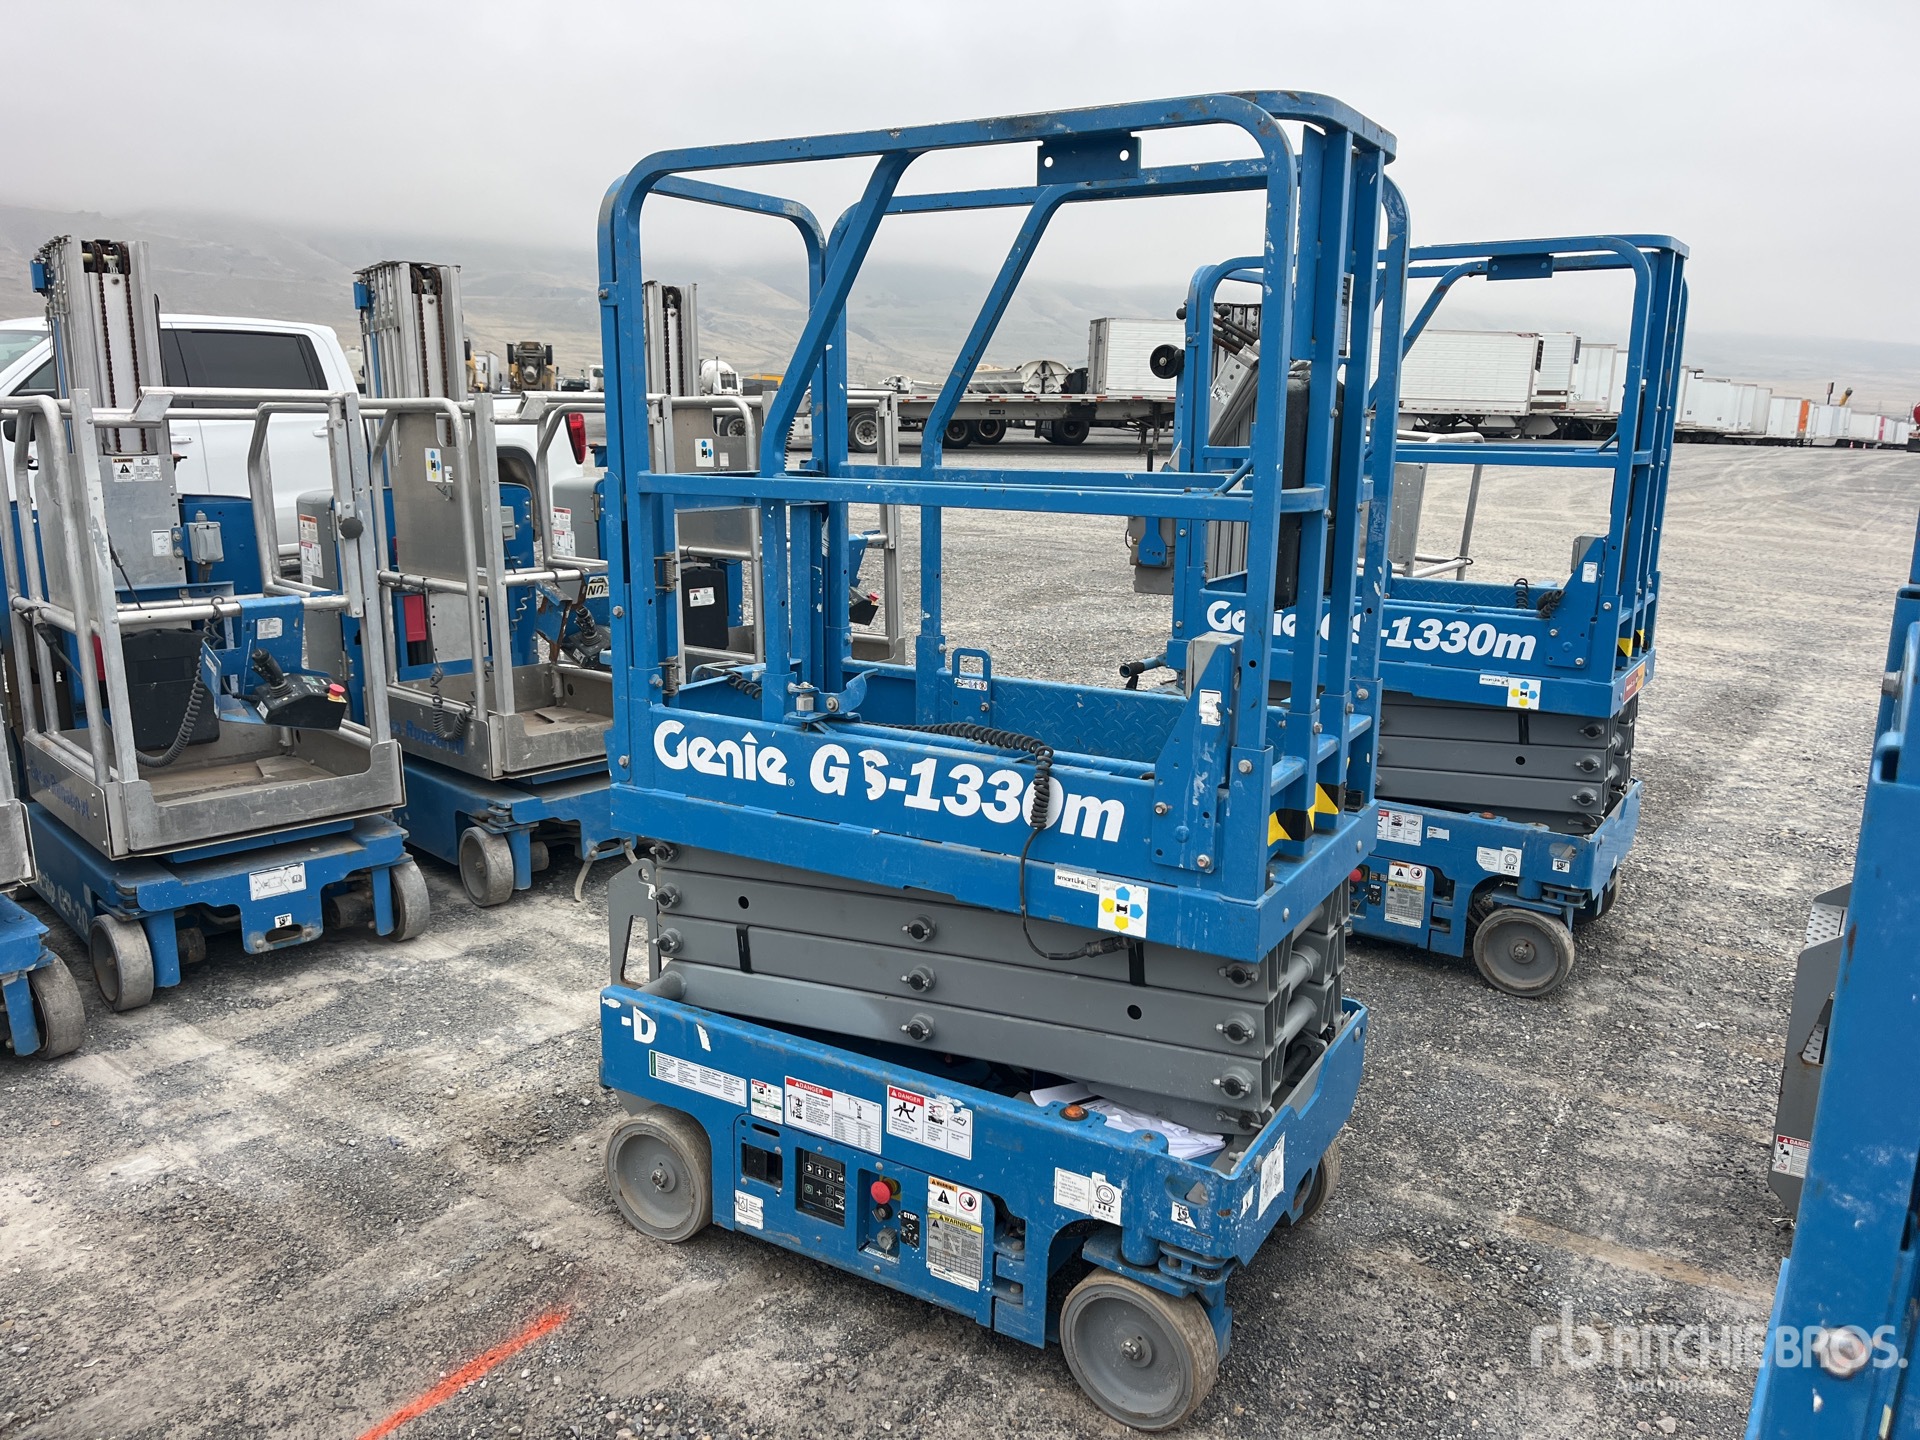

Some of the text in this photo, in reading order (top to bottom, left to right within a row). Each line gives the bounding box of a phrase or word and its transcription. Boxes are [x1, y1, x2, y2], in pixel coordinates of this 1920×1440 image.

[1206, 600, 1296, 638] Geie
[653, 720, 788, 786] Genie
[798, 1083, 824, 1095] DANGER
[897, 1092, 921, 1104] DANGER
[1790, 1139, 1810, 1148] DANGE
[903, 1211, 917, 1220] STOP
[944, 1216, 972, 1230] WARNING
